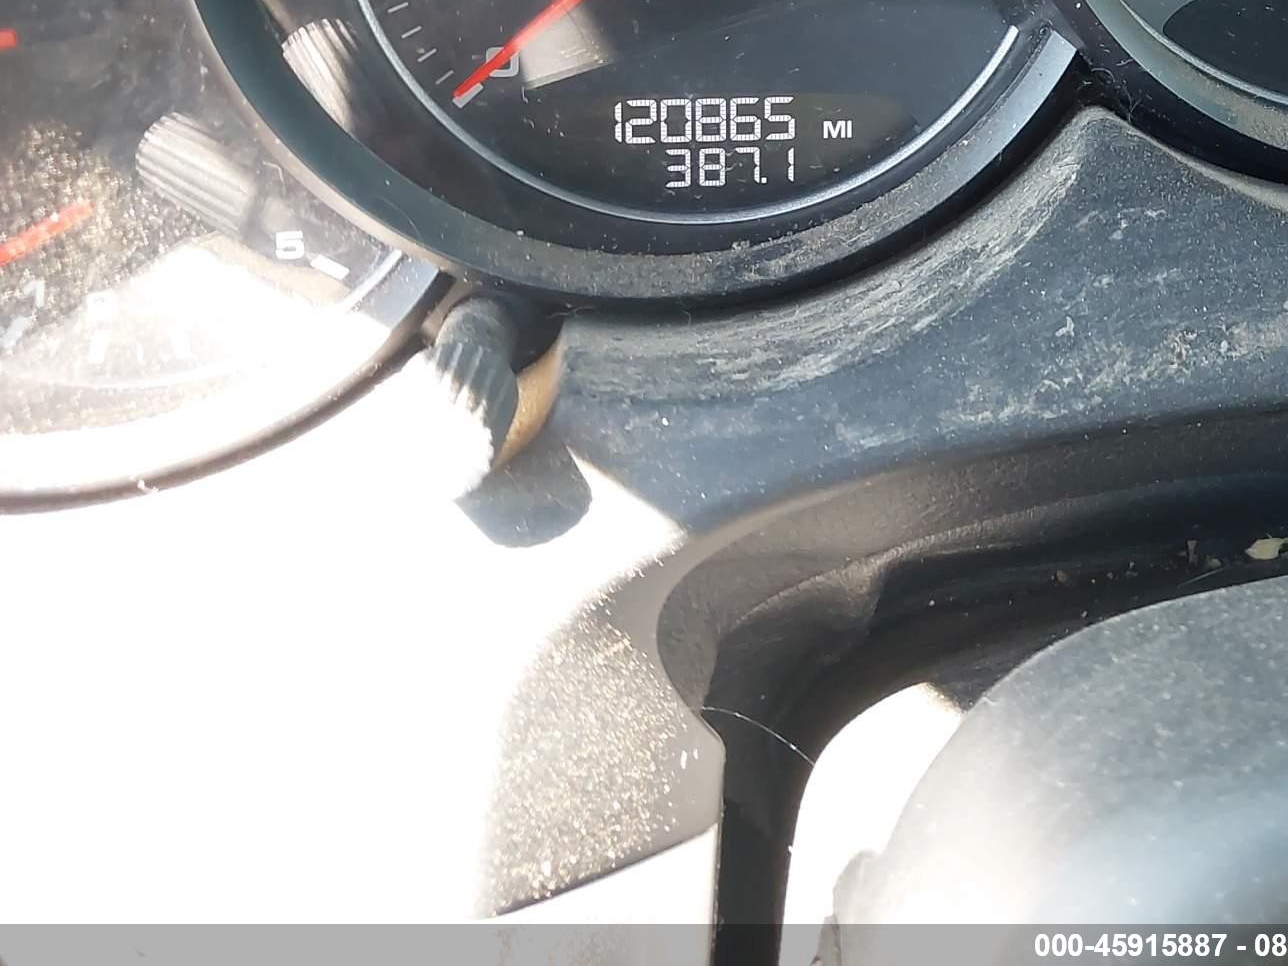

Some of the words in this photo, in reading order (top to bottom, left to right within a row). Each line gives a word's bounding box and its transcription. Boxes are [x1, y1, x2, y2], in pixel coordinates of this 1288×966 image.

[614, 96, 796, 144] 120865
[822, 120, 853, 139] MI
[665, 146, 795, 188] 387.1
[275, 231, 304, 260] 5
